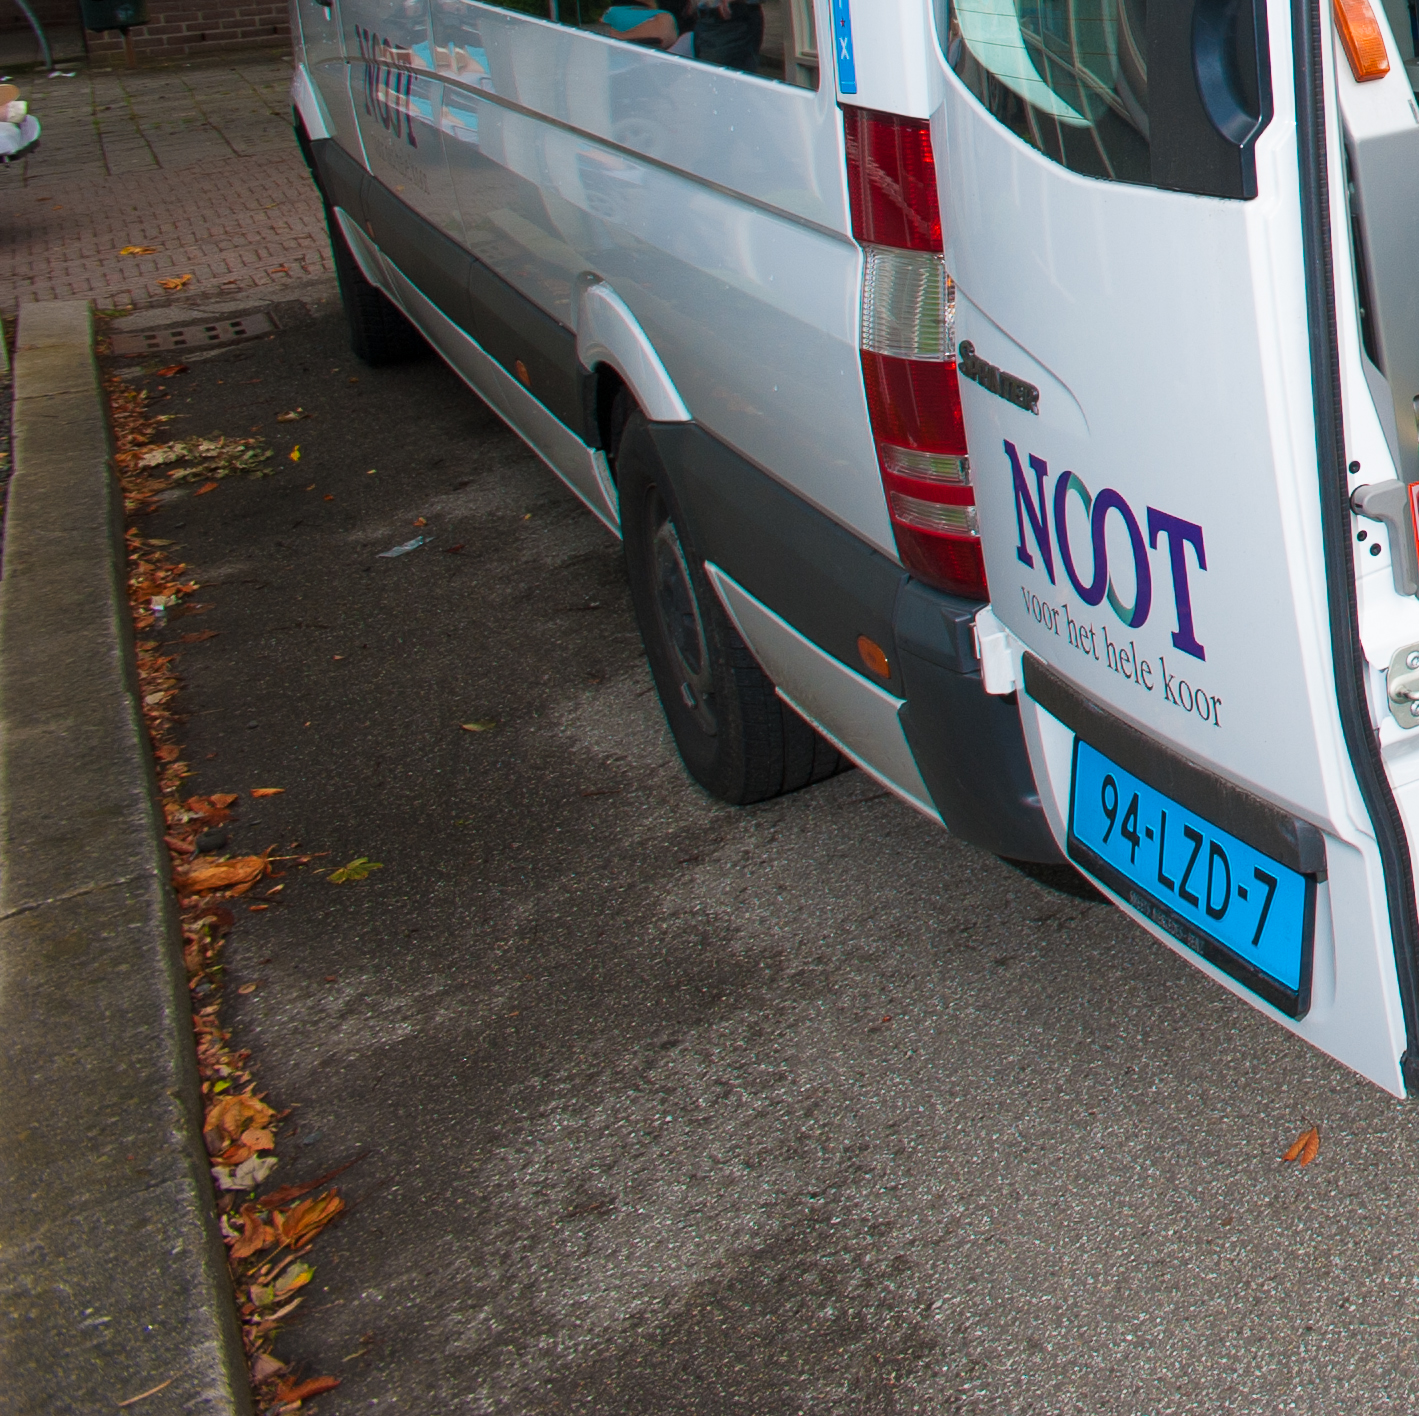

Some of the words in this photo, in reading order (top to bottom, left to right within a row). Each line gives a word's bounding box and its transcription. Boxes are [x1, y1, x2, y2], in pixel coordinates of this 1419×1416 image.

[1003, 438, 1208, 662] NOOT
[1021, 585, 1061, 637] voor
[1062, 603, 1100, 661] het
[1101, 625, 1155, 691] hele
[1158, 655, 1223, 728] koor
[1101, 772, 1279, 948] 94-LZD-7
